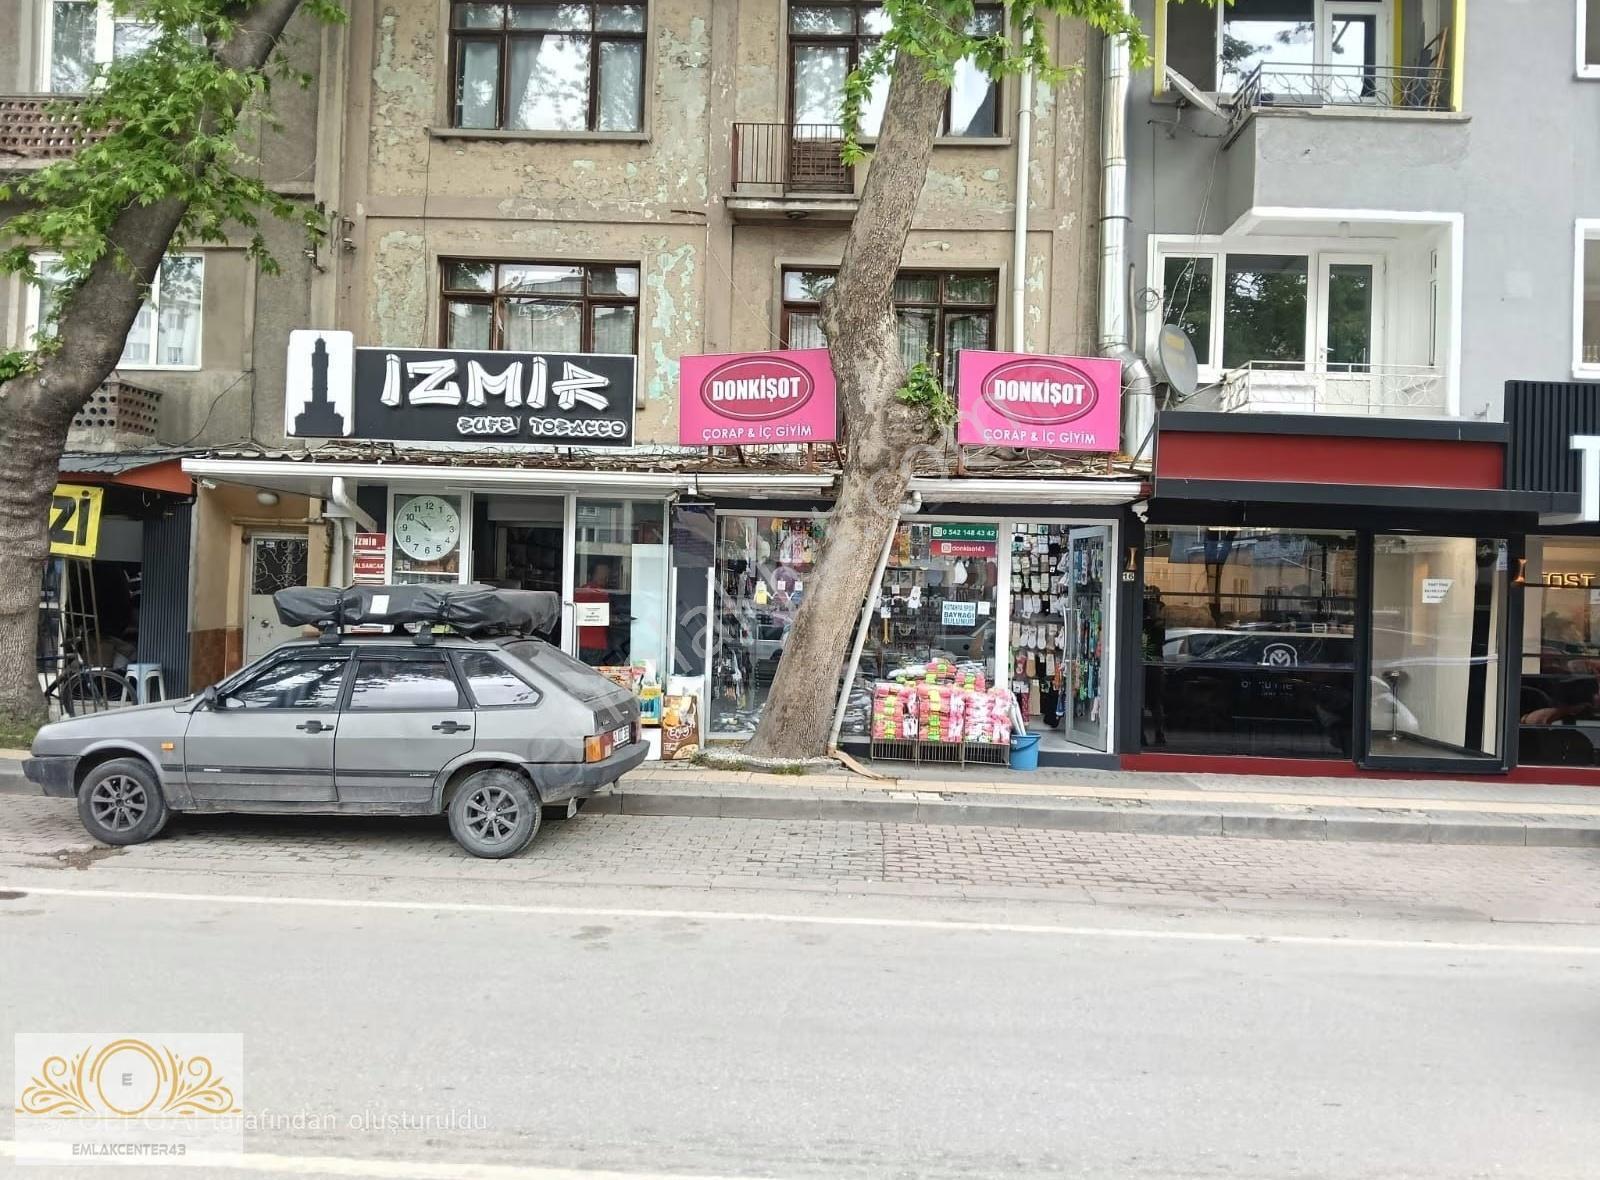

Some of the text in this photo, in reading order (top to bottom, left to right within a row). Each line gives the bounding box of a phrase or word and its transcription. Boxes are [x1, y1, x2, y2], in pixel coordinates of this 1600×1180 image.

[712, 375, 801, 402] DONKİŞOT
[993, 378, 1086, 407] DONKİŞOT
[529, 416, 627, 438] TOBACCO
[702, 424, 812, 441] ÇORAP & İÇ GİYİM
[983, 428, 1096, 445] ÇORAP & İÇ GİYİM
